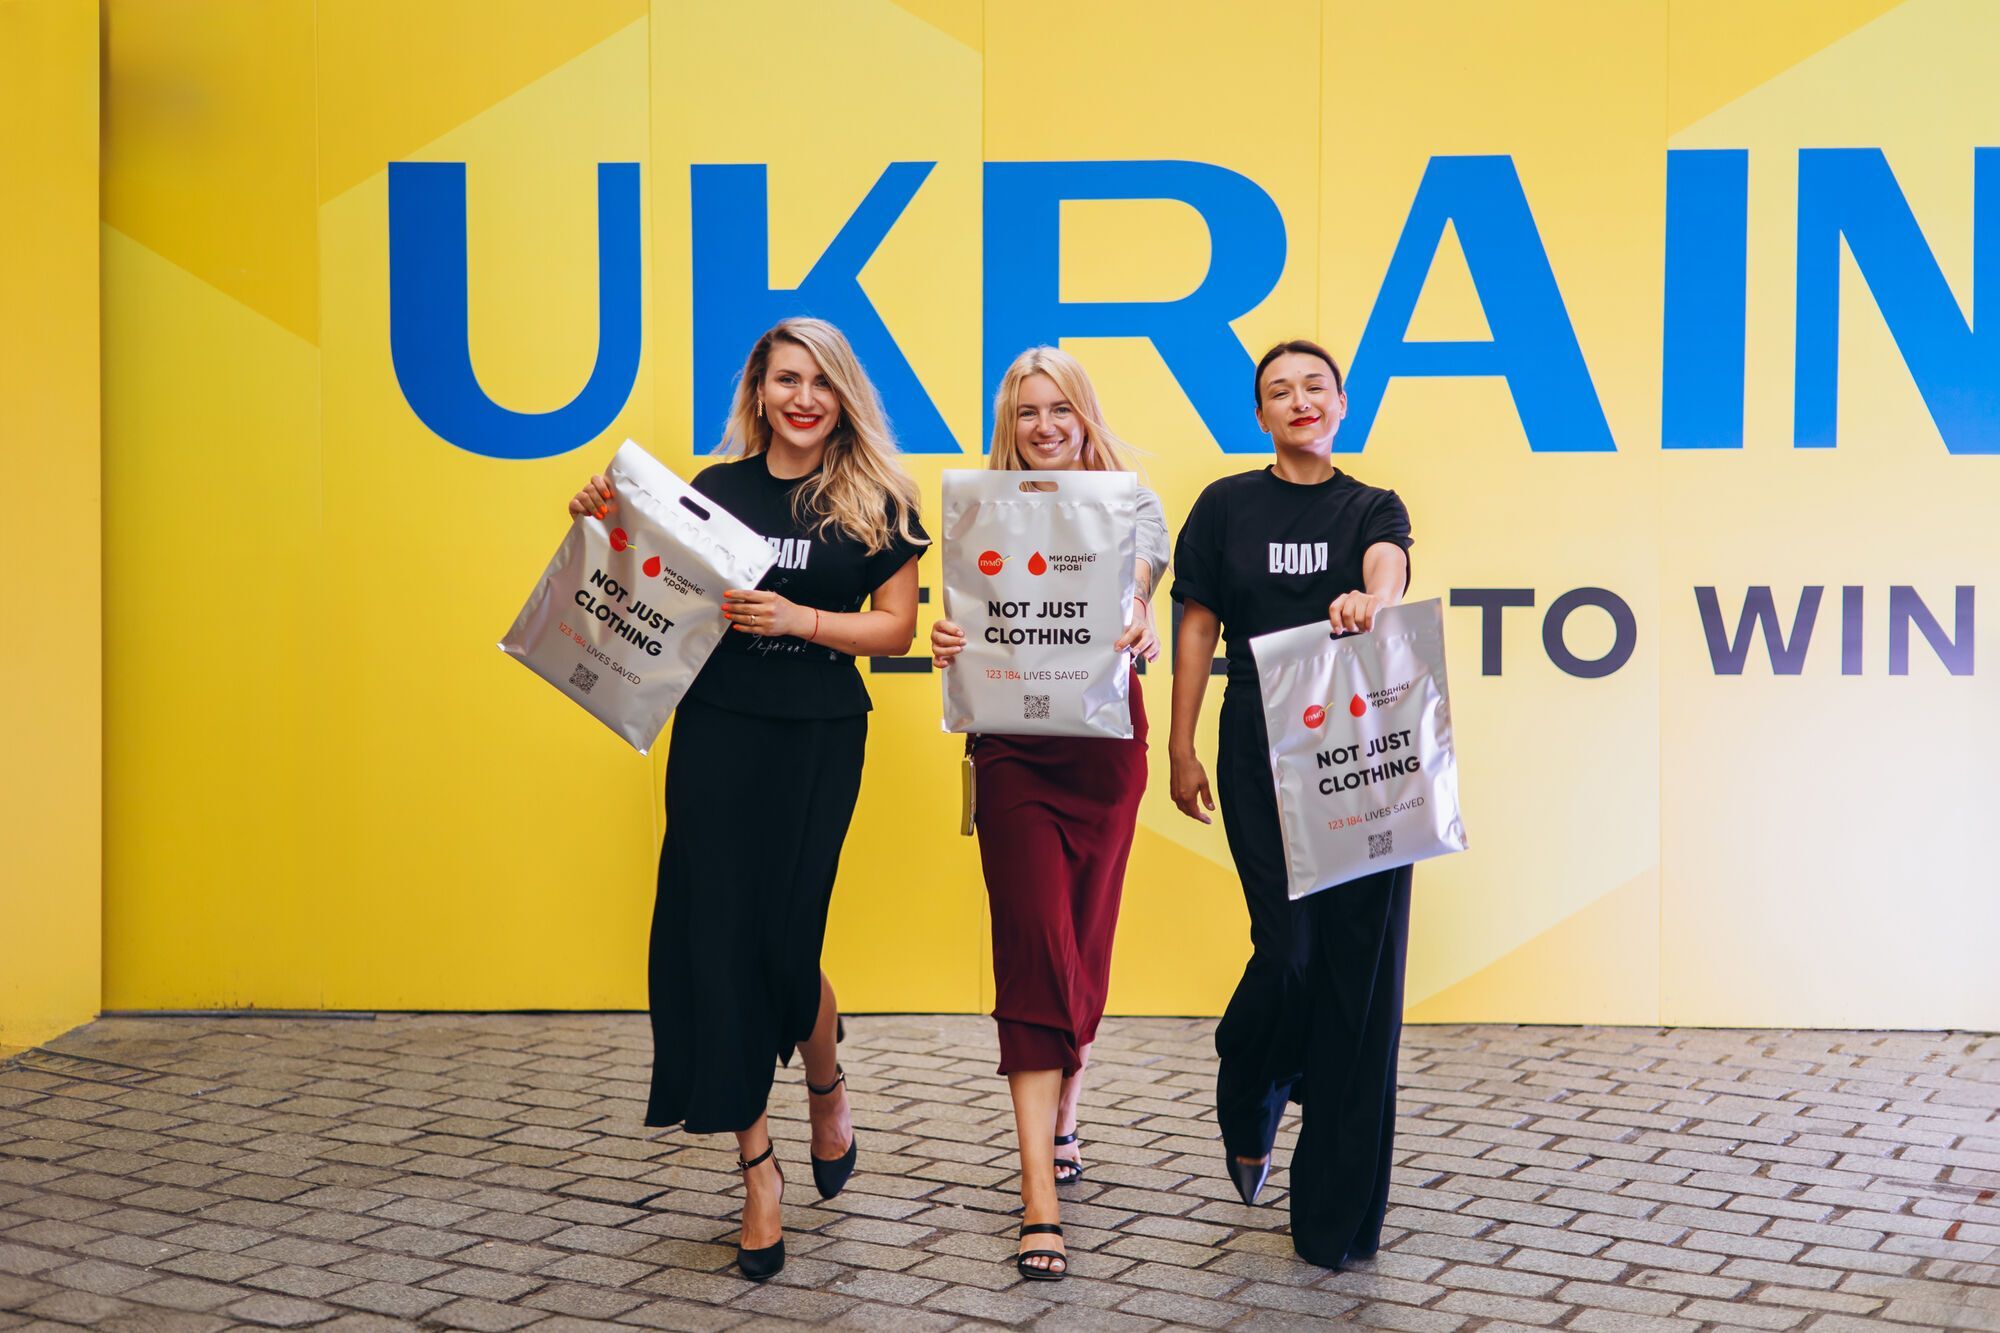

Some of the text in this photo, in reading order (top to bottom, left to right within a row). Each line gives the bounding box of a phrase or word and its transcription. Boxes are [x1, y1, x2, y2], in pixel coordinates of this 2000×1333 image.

[388, 146, 2000, 460] UKRAIN
[1053, 563, 1082, 573] крові
[1064, 553, 1096, 563] однієї
[1269, 542, 1328, 575] ВОЛЯ
[663, 566, 705, 596] ми однієї
[663, 576, 689, 596] крові
[589, 568, 675, 635] NOT JUST
[988, 600, 1088, 619] NOT JUST
[574, 589, 663, 657] CLOTHING
[984, 627, 1091, 645] CLOTHING
[1450, 585, 1976, 678] TO WIN
[586, 644, 612, 666] LIVES
[610, 661, 641, 686] SAVED
[985, 669, 1089, 681] 123 184 LIVES SAVED
[1366, 690, 1380, 700] ми
[1316, 729, 1411, 769] NOT JUST
[1318, 755, 1421, 796] CLOTHING
[1328, 796, 1425, 831] 123 184 LIVES SAVED
